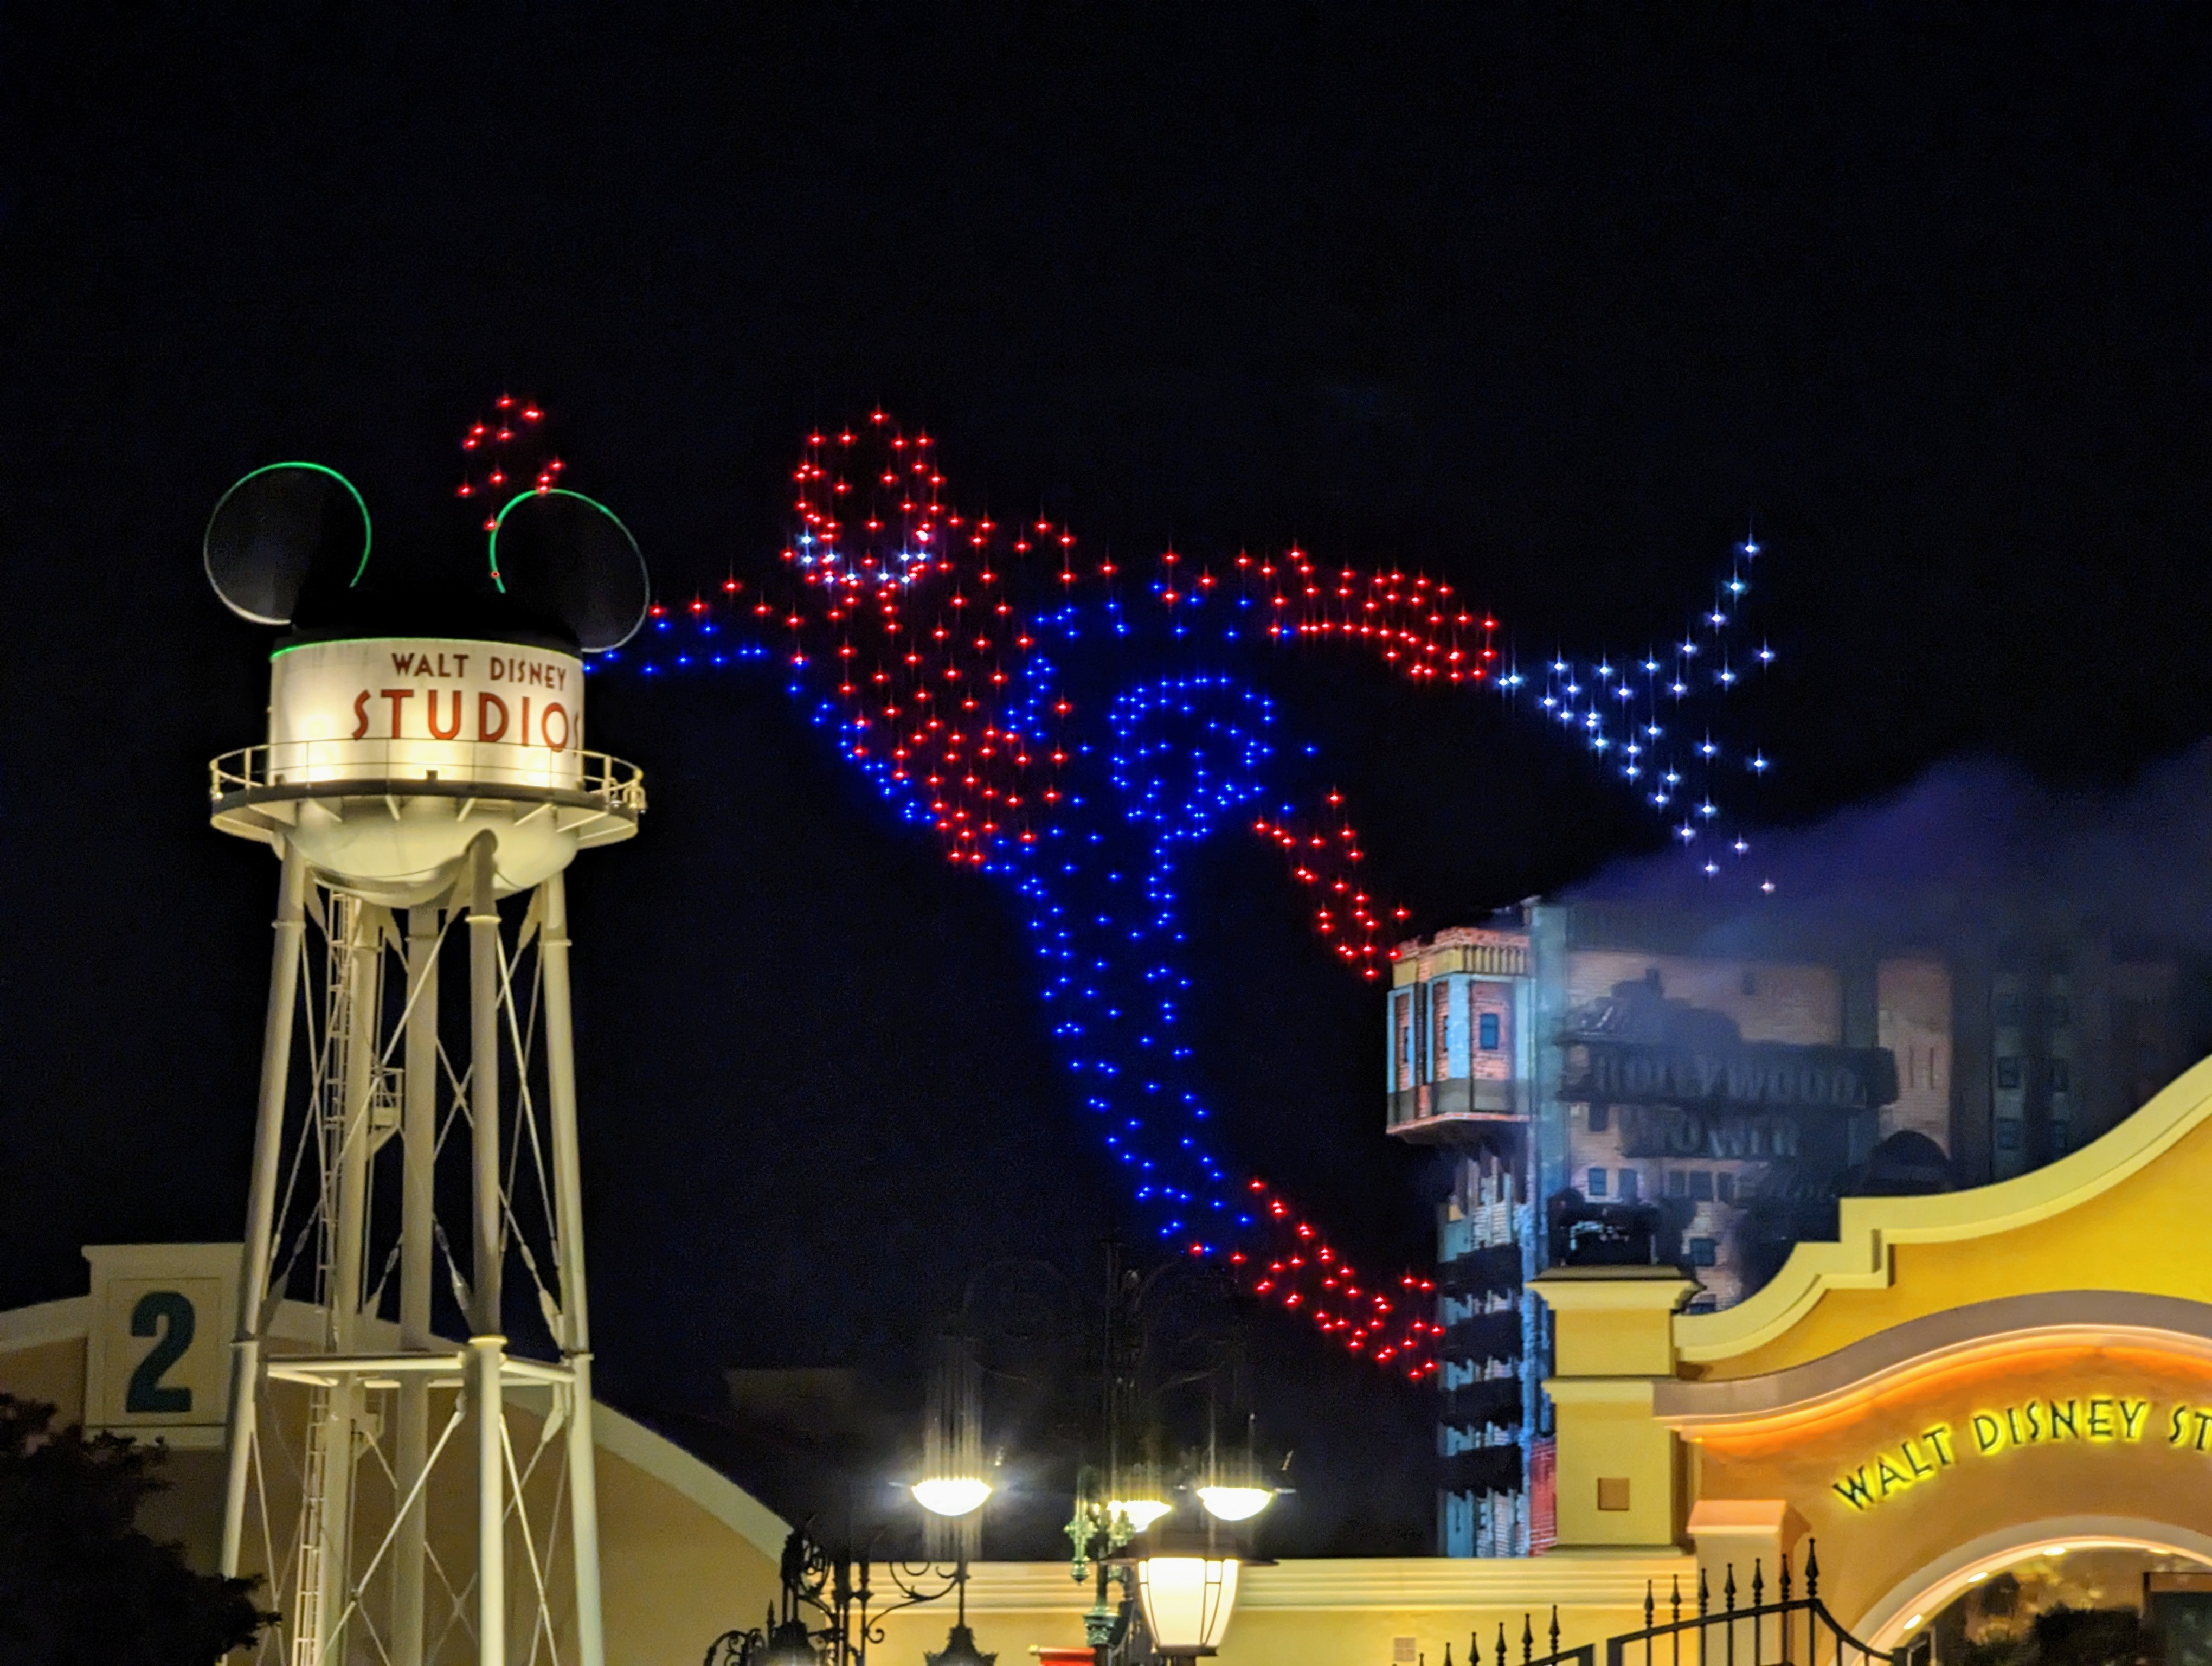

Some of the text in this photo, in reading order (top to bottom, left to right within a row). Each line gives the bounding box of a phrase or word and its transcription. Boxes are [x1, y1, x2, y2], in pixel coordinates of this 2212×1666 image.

[391, 652, 567, 691] WALT DISNEY
[352, 689, 580, 758] STUDIOS
[125, 1291, 195, 1413] 2
[1832, 1426, 1954, 1510] WALT
[1973, 1399, 2146, 1451] DISNEY
